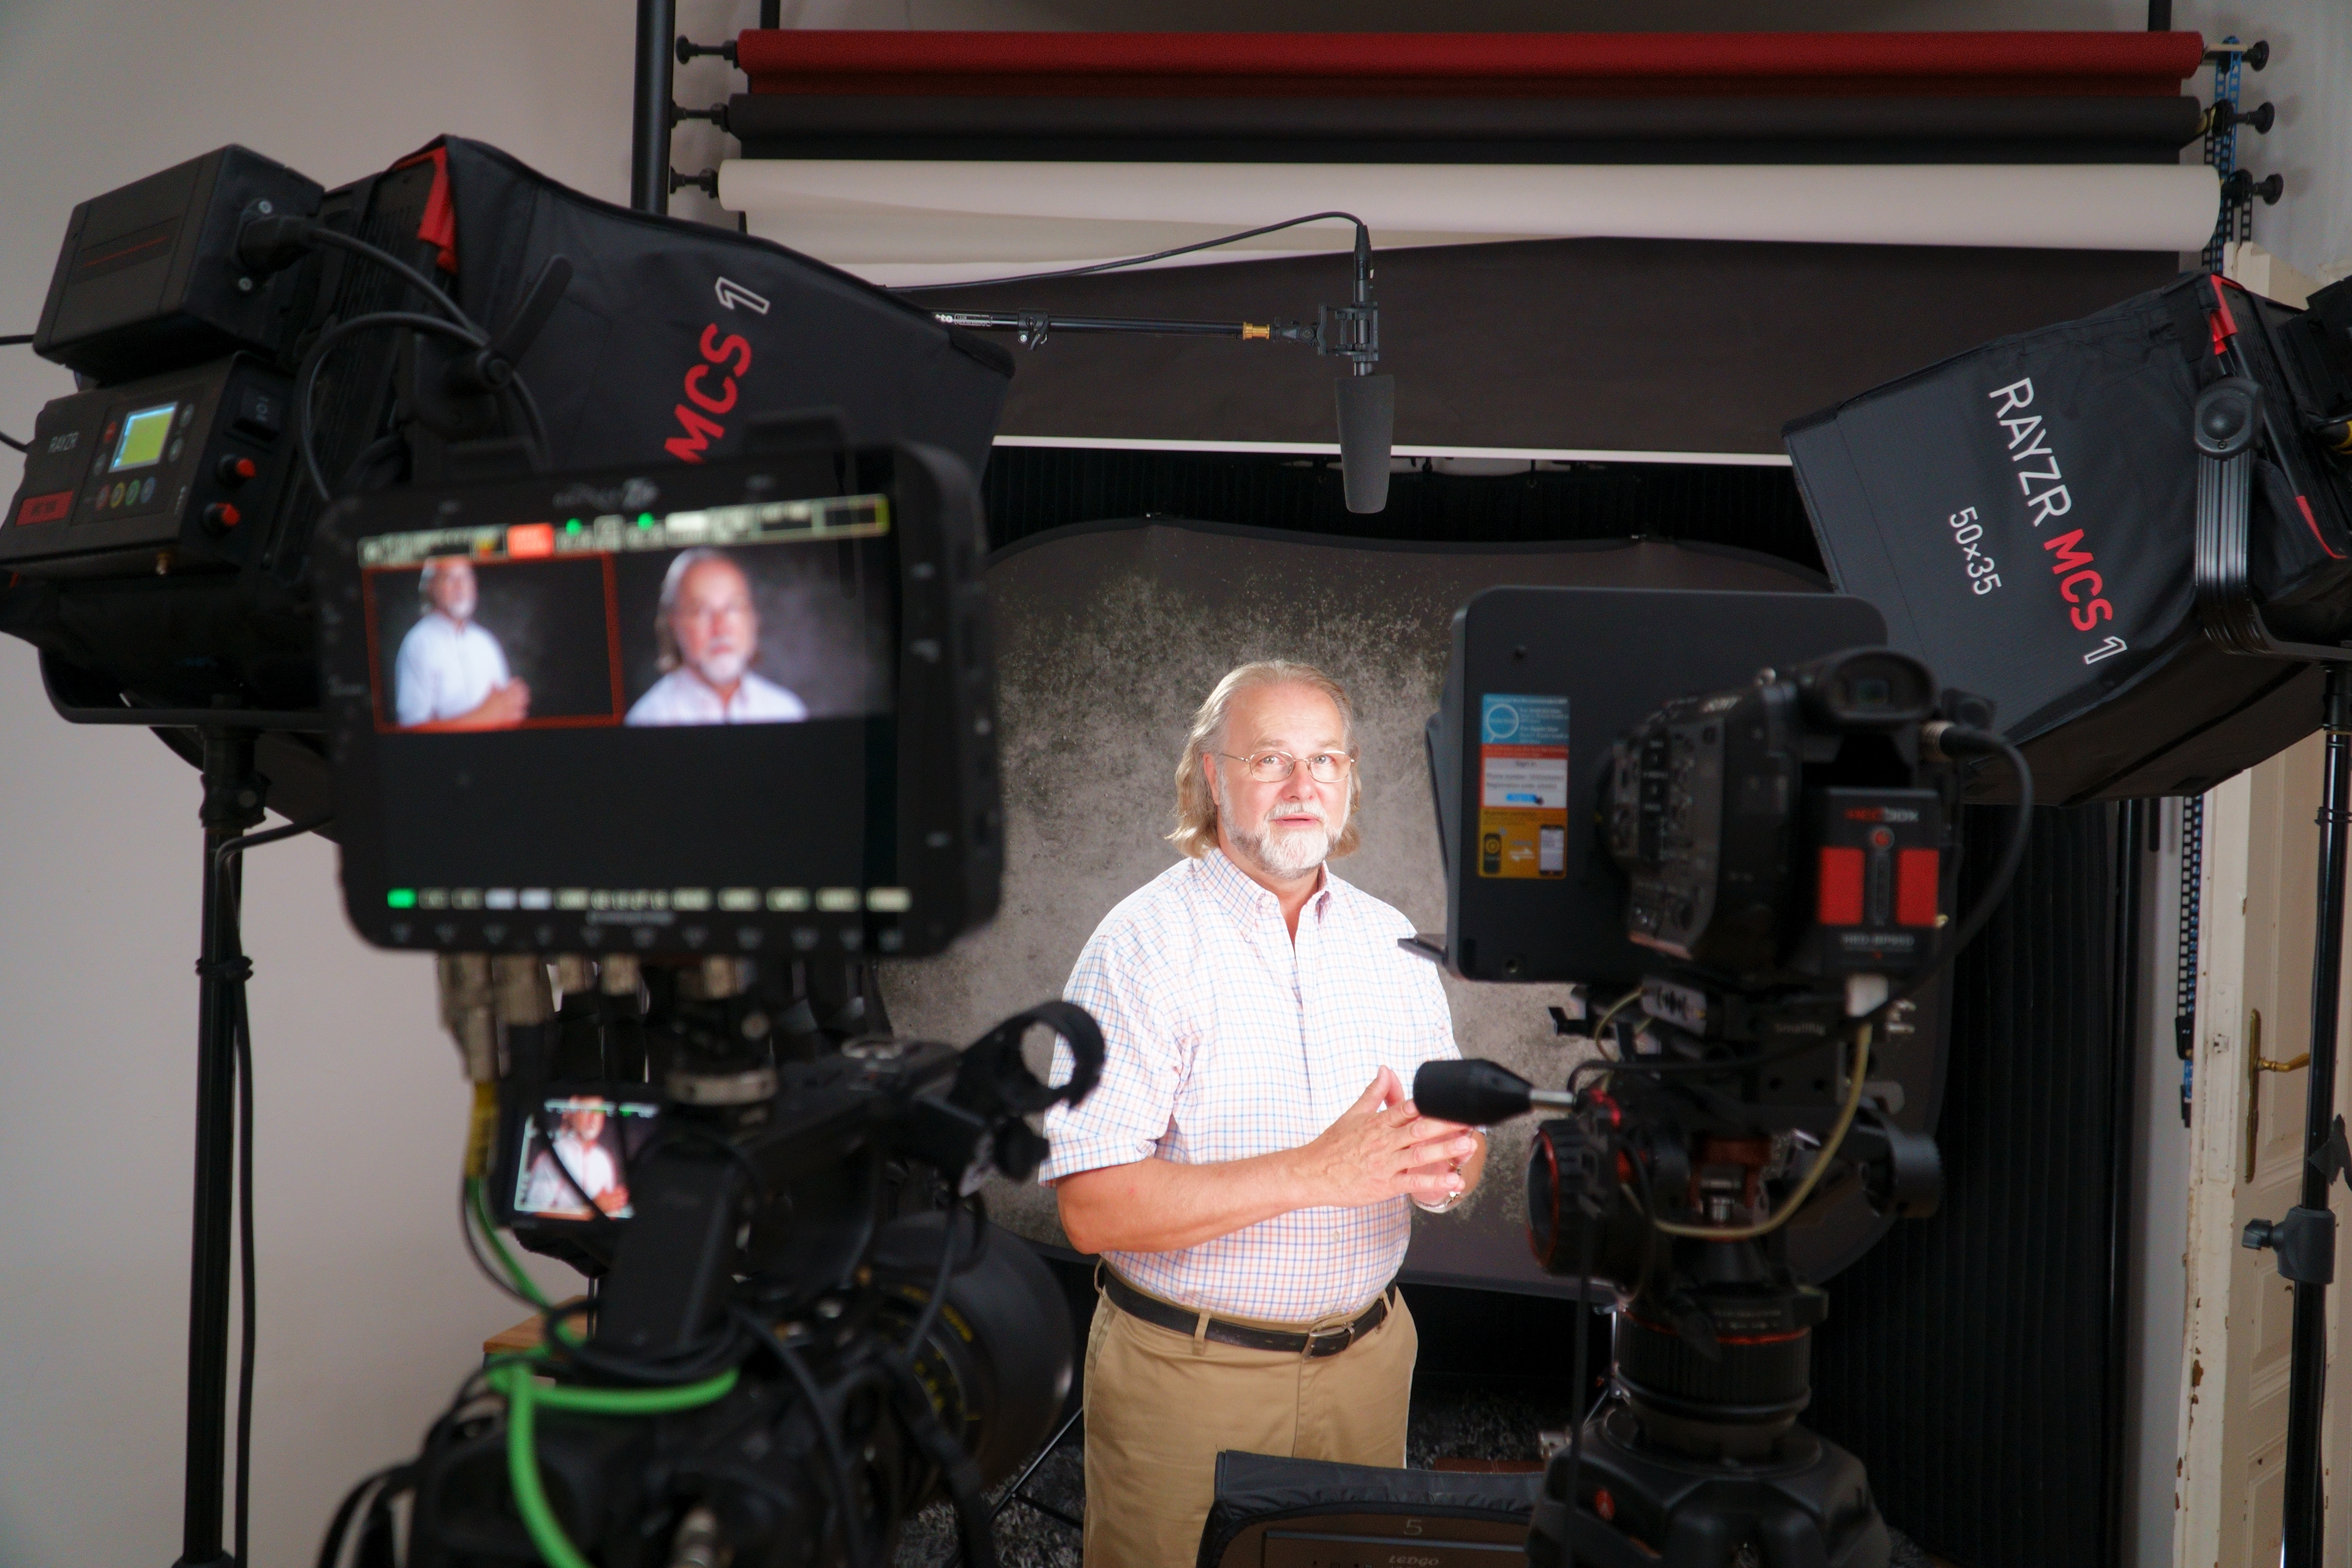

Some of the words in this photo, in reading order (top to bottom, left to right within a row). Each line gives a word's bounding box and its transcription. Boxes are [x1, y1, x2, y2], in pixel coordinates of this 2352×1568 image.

[664, 323, 752, 463] MCS
[715, 277, 769, 314] 1
[1989, 377, 2071, 527] RAYZR
[2043, 528, 2114, 631] MCS
[2084, 636, 2127, 665] 1
[1403, 1519, 1423, 1536] 5
